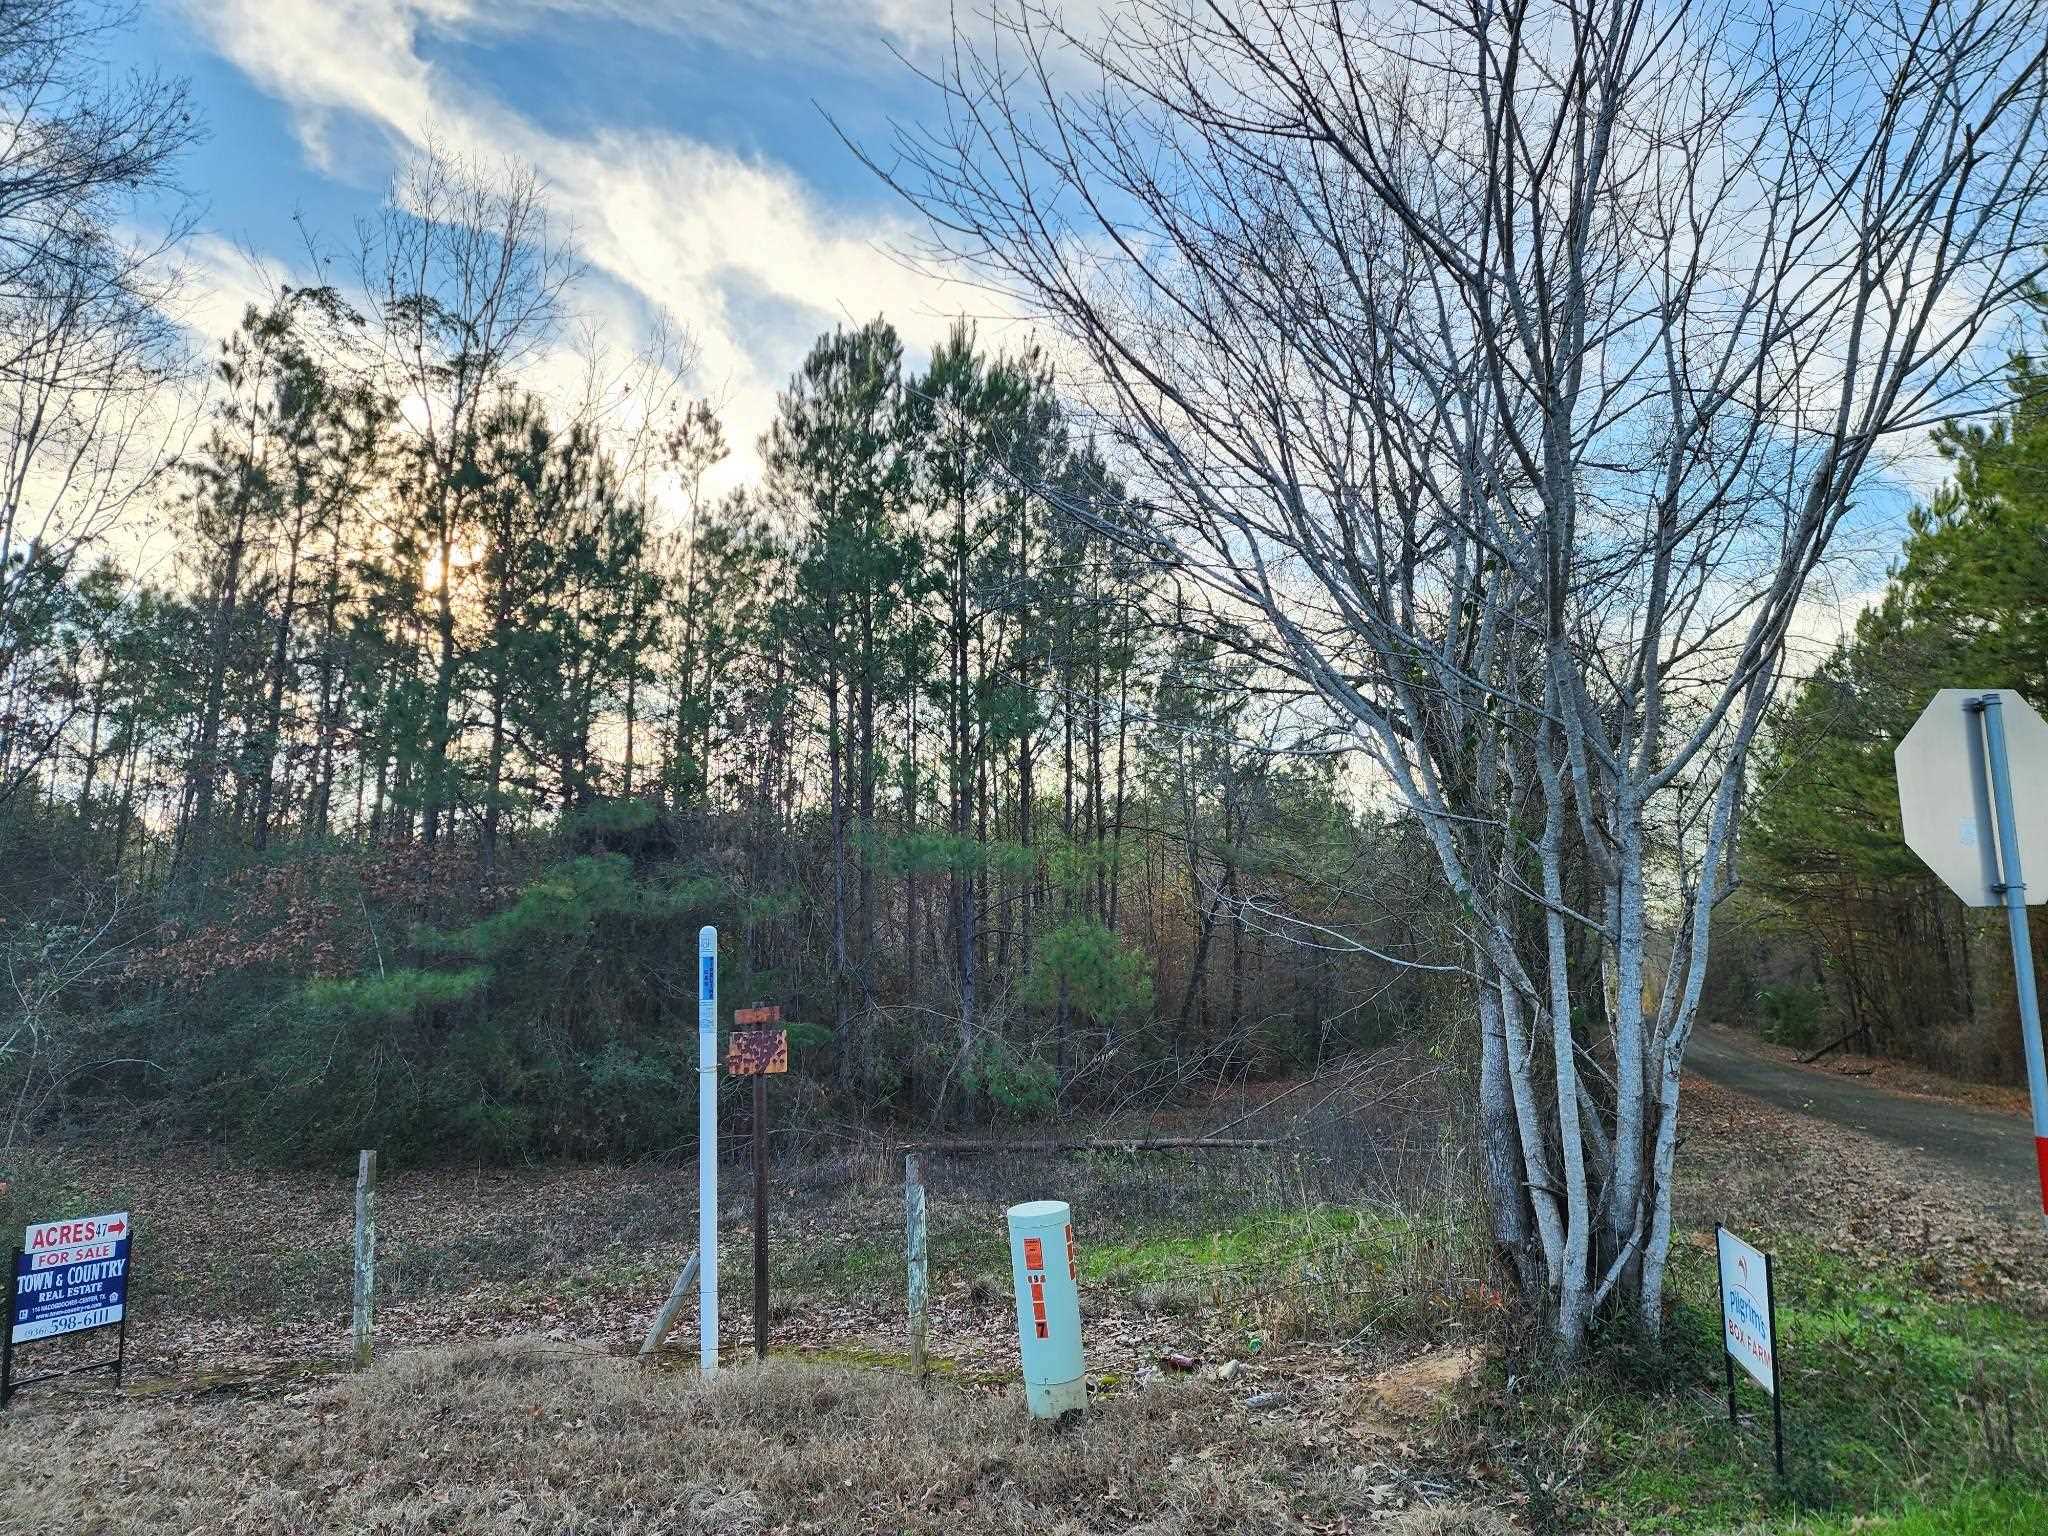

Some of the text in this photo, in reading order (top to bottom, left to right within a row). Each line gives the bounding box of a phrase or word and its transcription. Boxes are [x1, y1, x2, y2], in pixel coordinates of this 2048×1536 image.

[32, 1222, 95, 1249] ACRES
[38, 1245, 110, 1267] FOR SALE
[17, 1258, 126, 1295] TOWN & COUNTRY
[39, 1282, 103, 1303] REAL ESTATE
[50, 1309, 109, 1333] 598-6111
[1730, 1289, 1766, 1340] Pilgrim's
[1729, 1319, 1745, 1344] BOX
